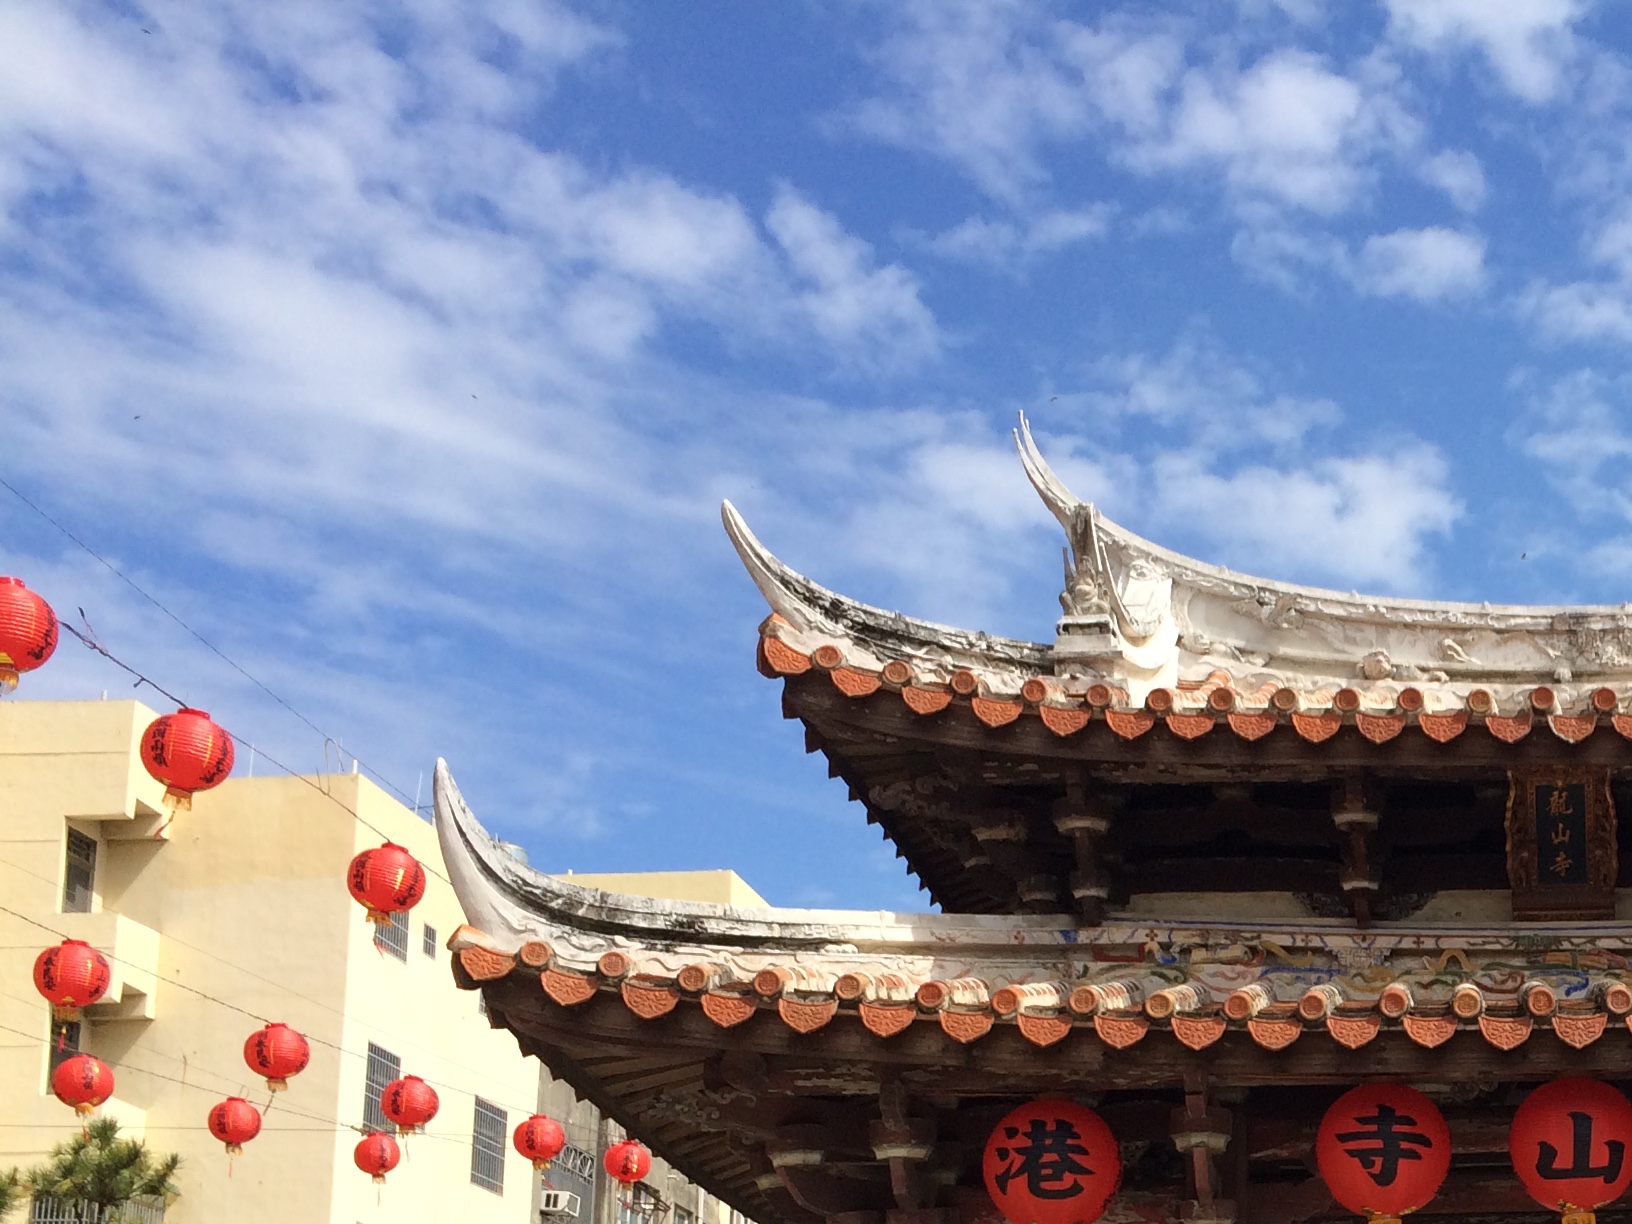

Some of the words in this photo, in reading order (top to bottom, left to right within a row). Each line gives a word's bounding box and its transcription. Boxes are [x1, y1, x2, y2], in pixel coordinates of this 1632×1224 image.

[1546, 790, 1574, 877] 龍山寺
[995, 1118, 1096, 1200] 港
[1336, 1103, 1433, 1187] 寺
[1535, 1111, 1625, 1185] 山
